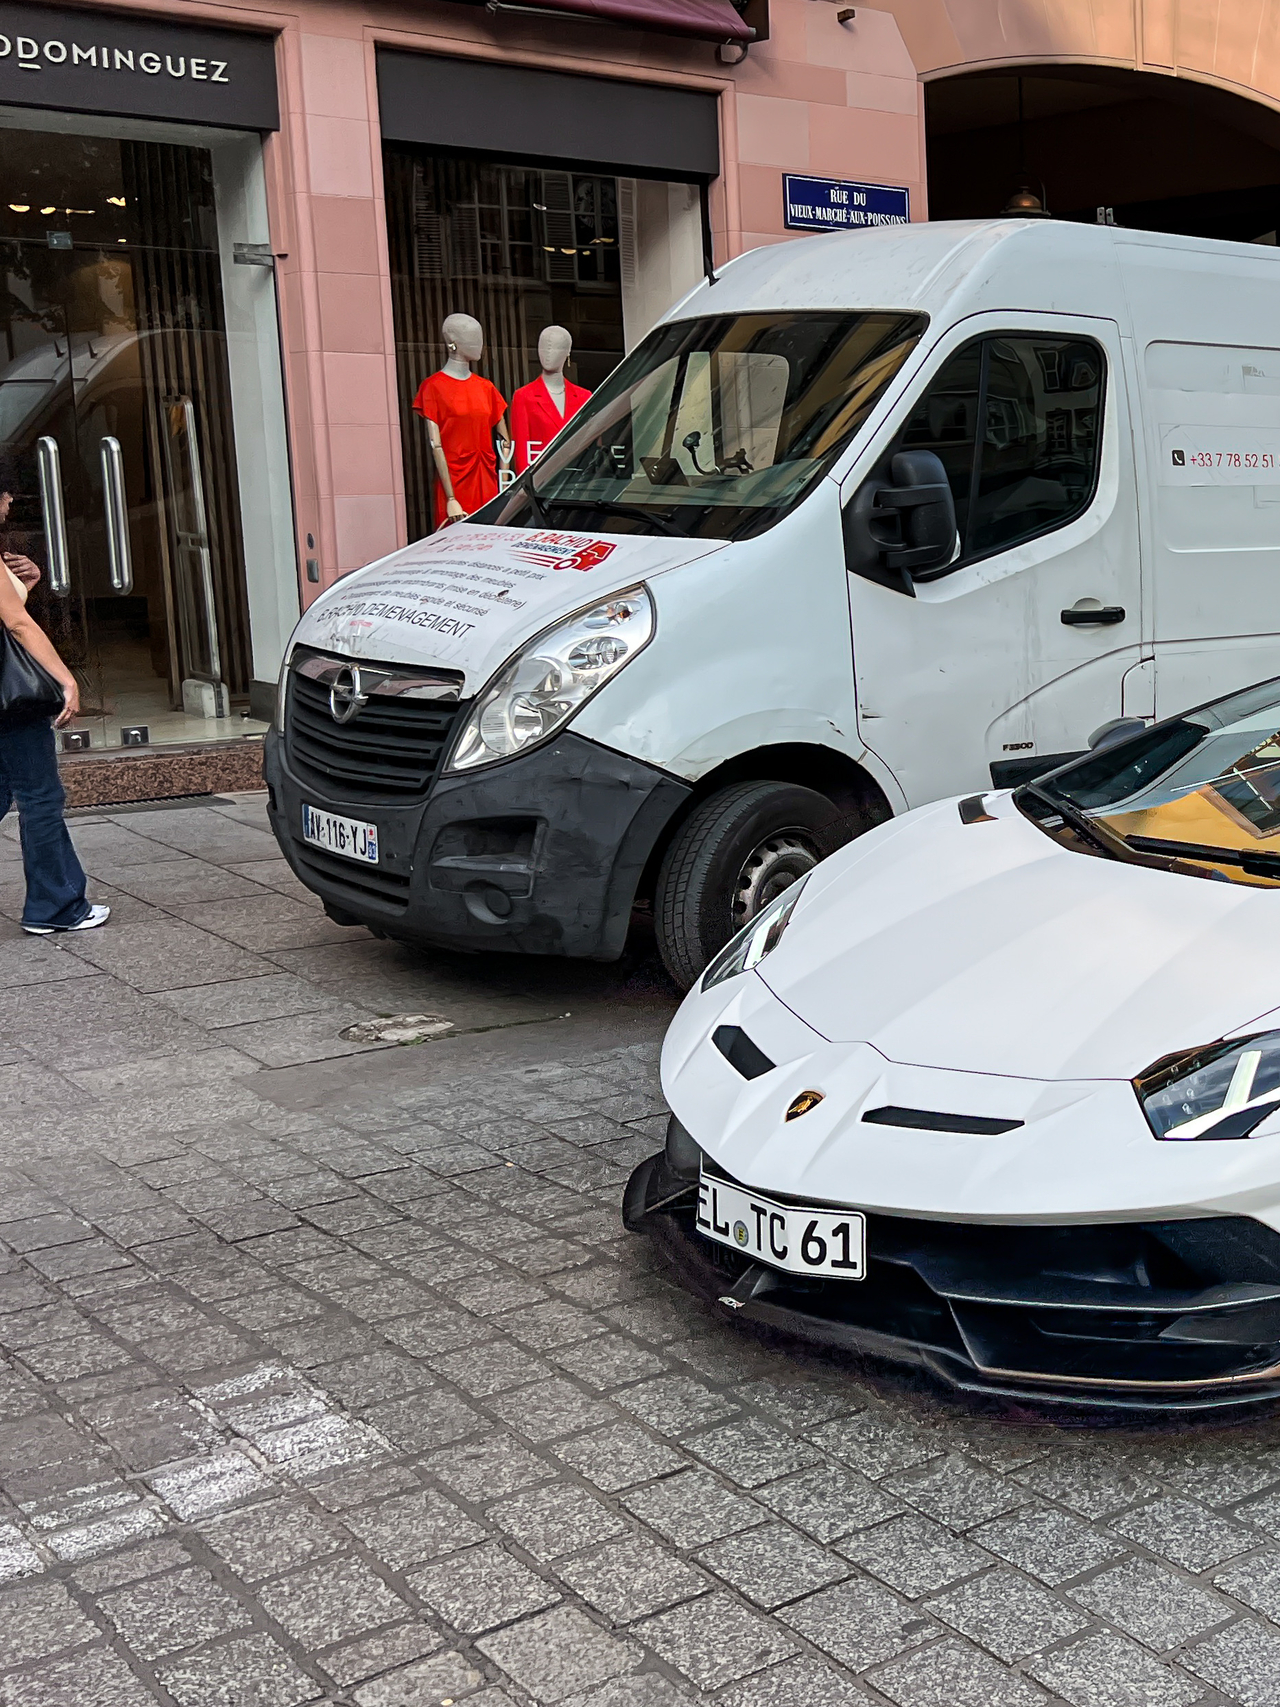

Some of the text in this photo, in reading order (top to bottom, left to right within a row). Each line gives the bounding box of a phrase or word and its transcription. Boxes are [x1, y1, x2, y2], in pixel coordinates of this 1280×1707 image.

[830, 189, 867, 206] RUE DU
[1190, 453, 1213, 467] +33
[1215, 453, 1222, 467] 7
[1226, 453, 1241, 468] 78
[1244, 453, 1259, 468] 52
[1262, 454, 1275, 468] 51
[525, 531, 593, 549] B.RACHID
[507, 568, 532, 577] petit
[525, 572, 548, 581] prix
[361, 603, 476, 639] DEMENAGEMENT
[750, 1202, 789, 1261] TC
[800, 1220, 858, 1270] 61
